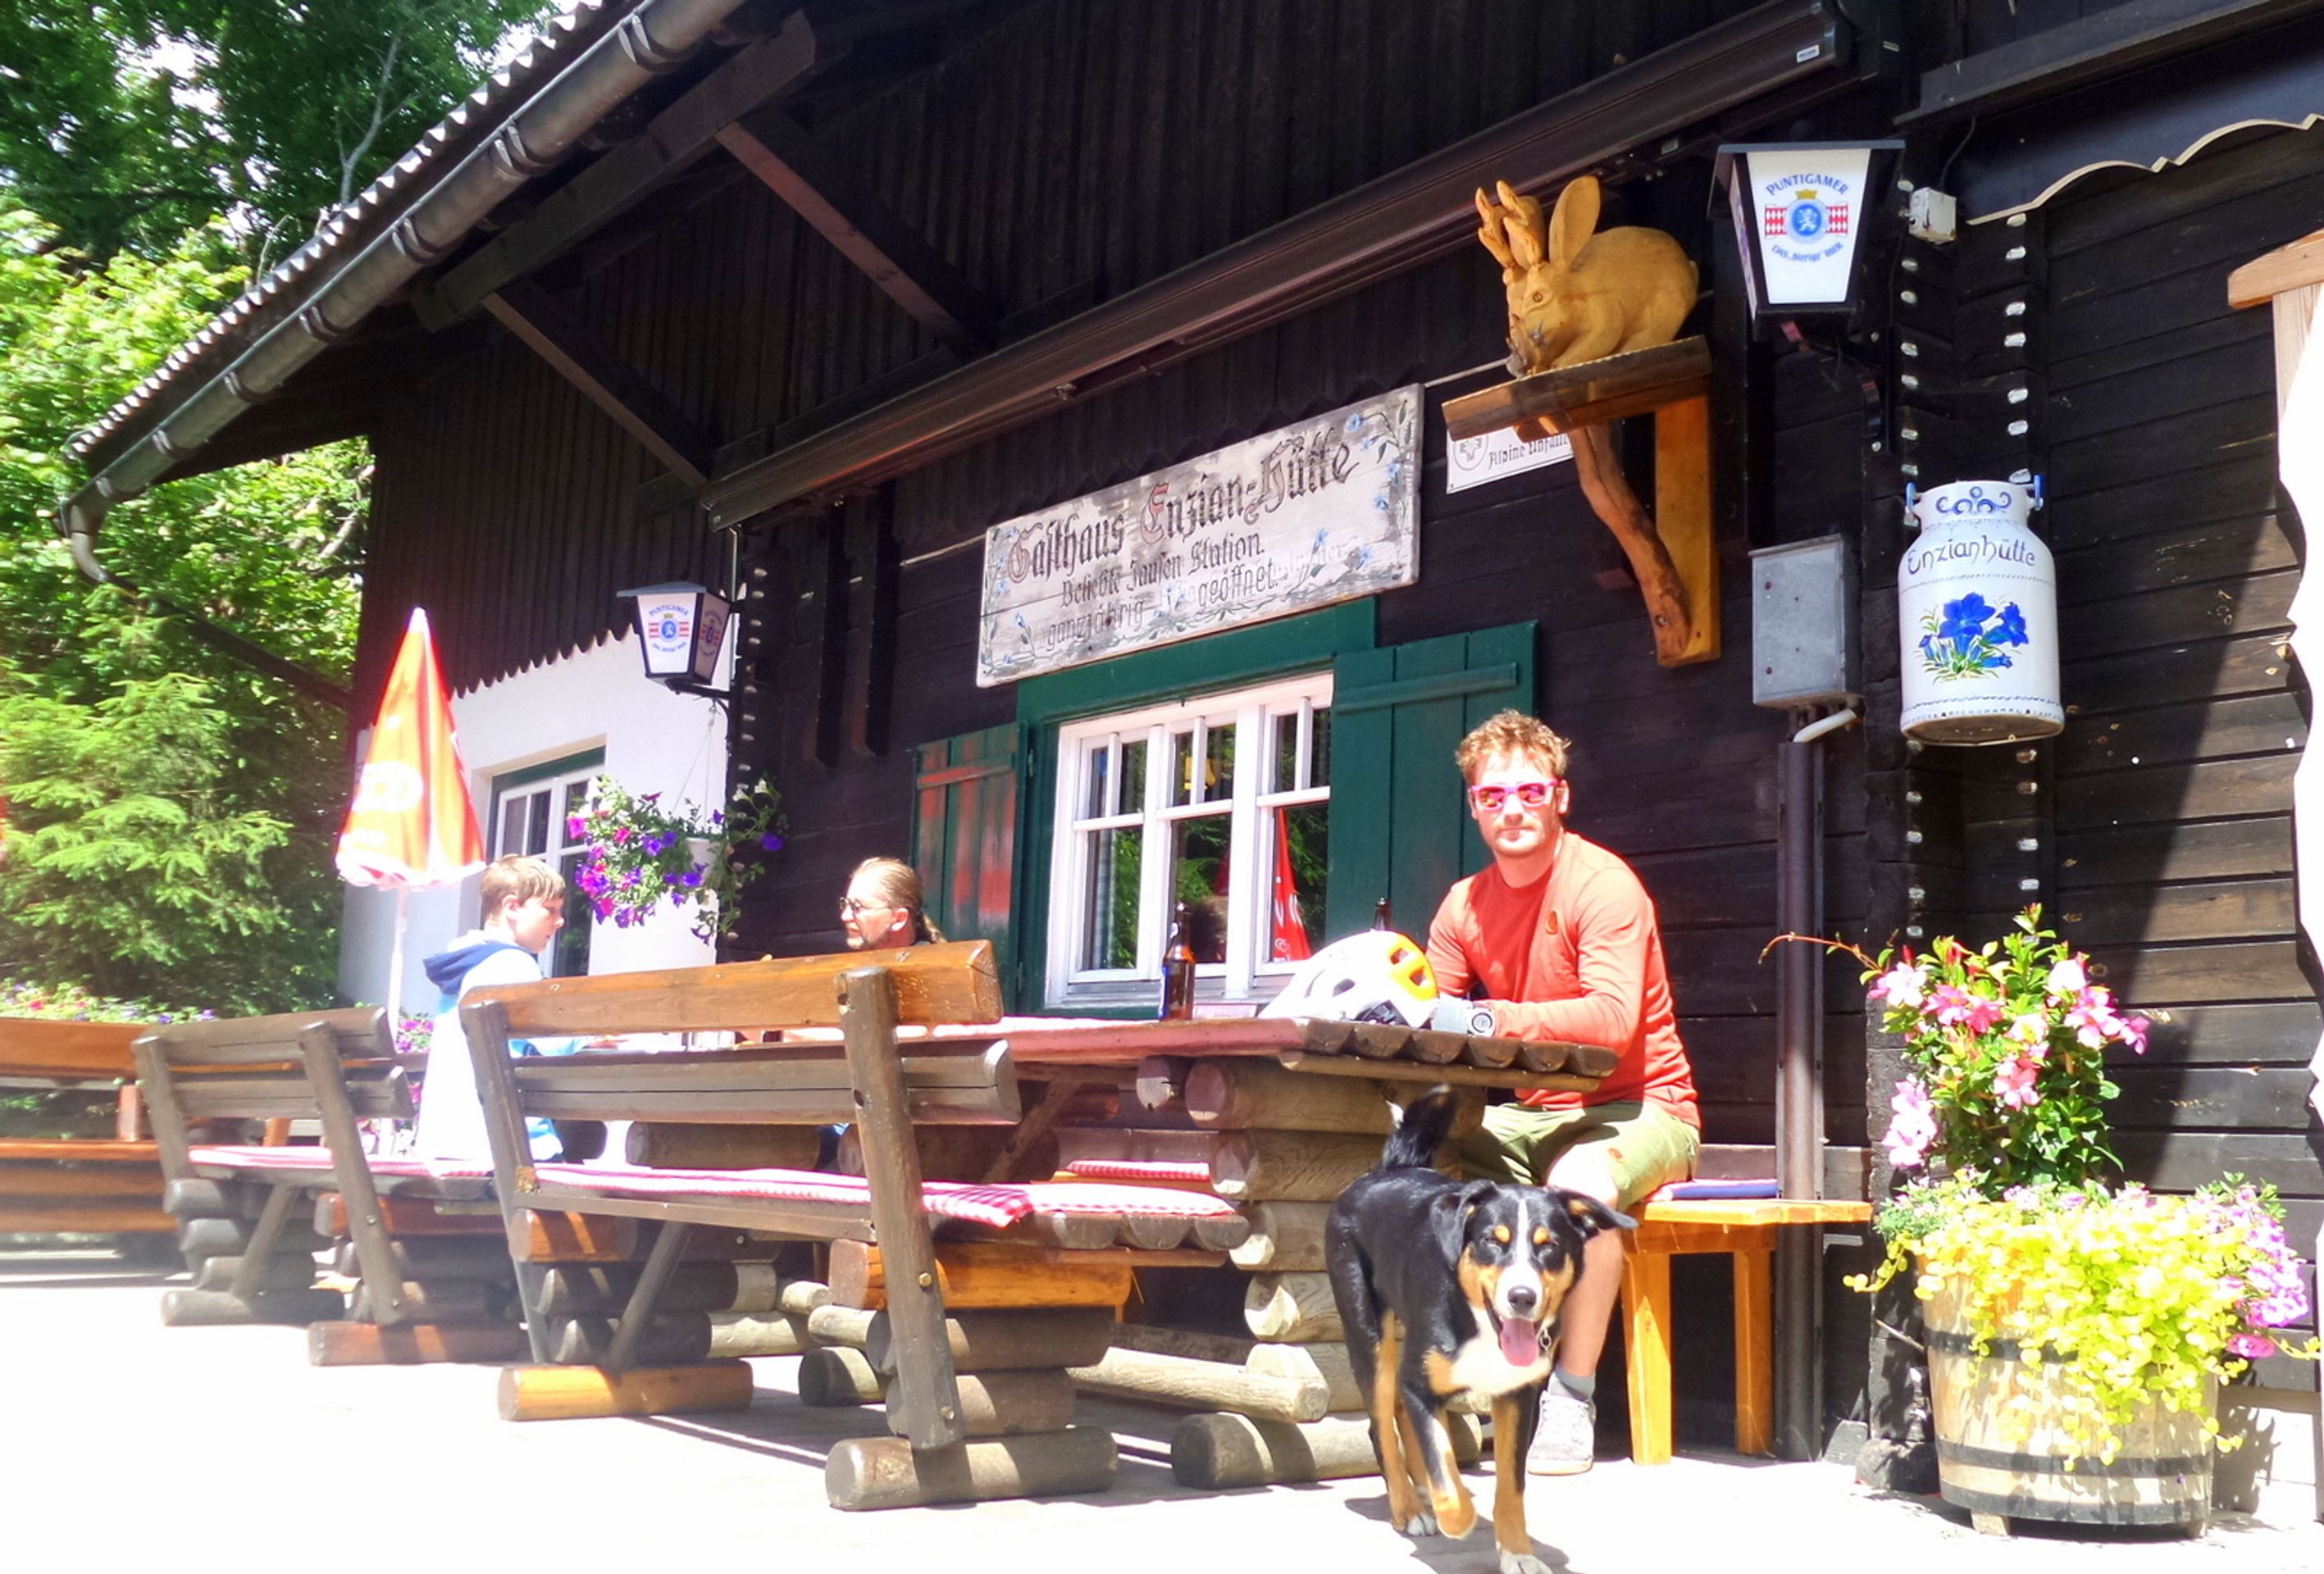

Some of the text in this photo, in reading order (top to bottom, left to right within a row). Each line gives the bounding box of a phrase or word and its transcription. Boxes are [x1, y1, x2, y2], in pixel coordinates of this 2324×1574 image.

[1766, 173, 1848, 195] PUNTIGAMER
[1488, 444, 1525, 471] Alpine
[1007, 512, 1125, 584] Gasthaus
[1907, 535, 2035, 575] Enzianhütte
[1046, 599, 1146, 652] ganzjährig
